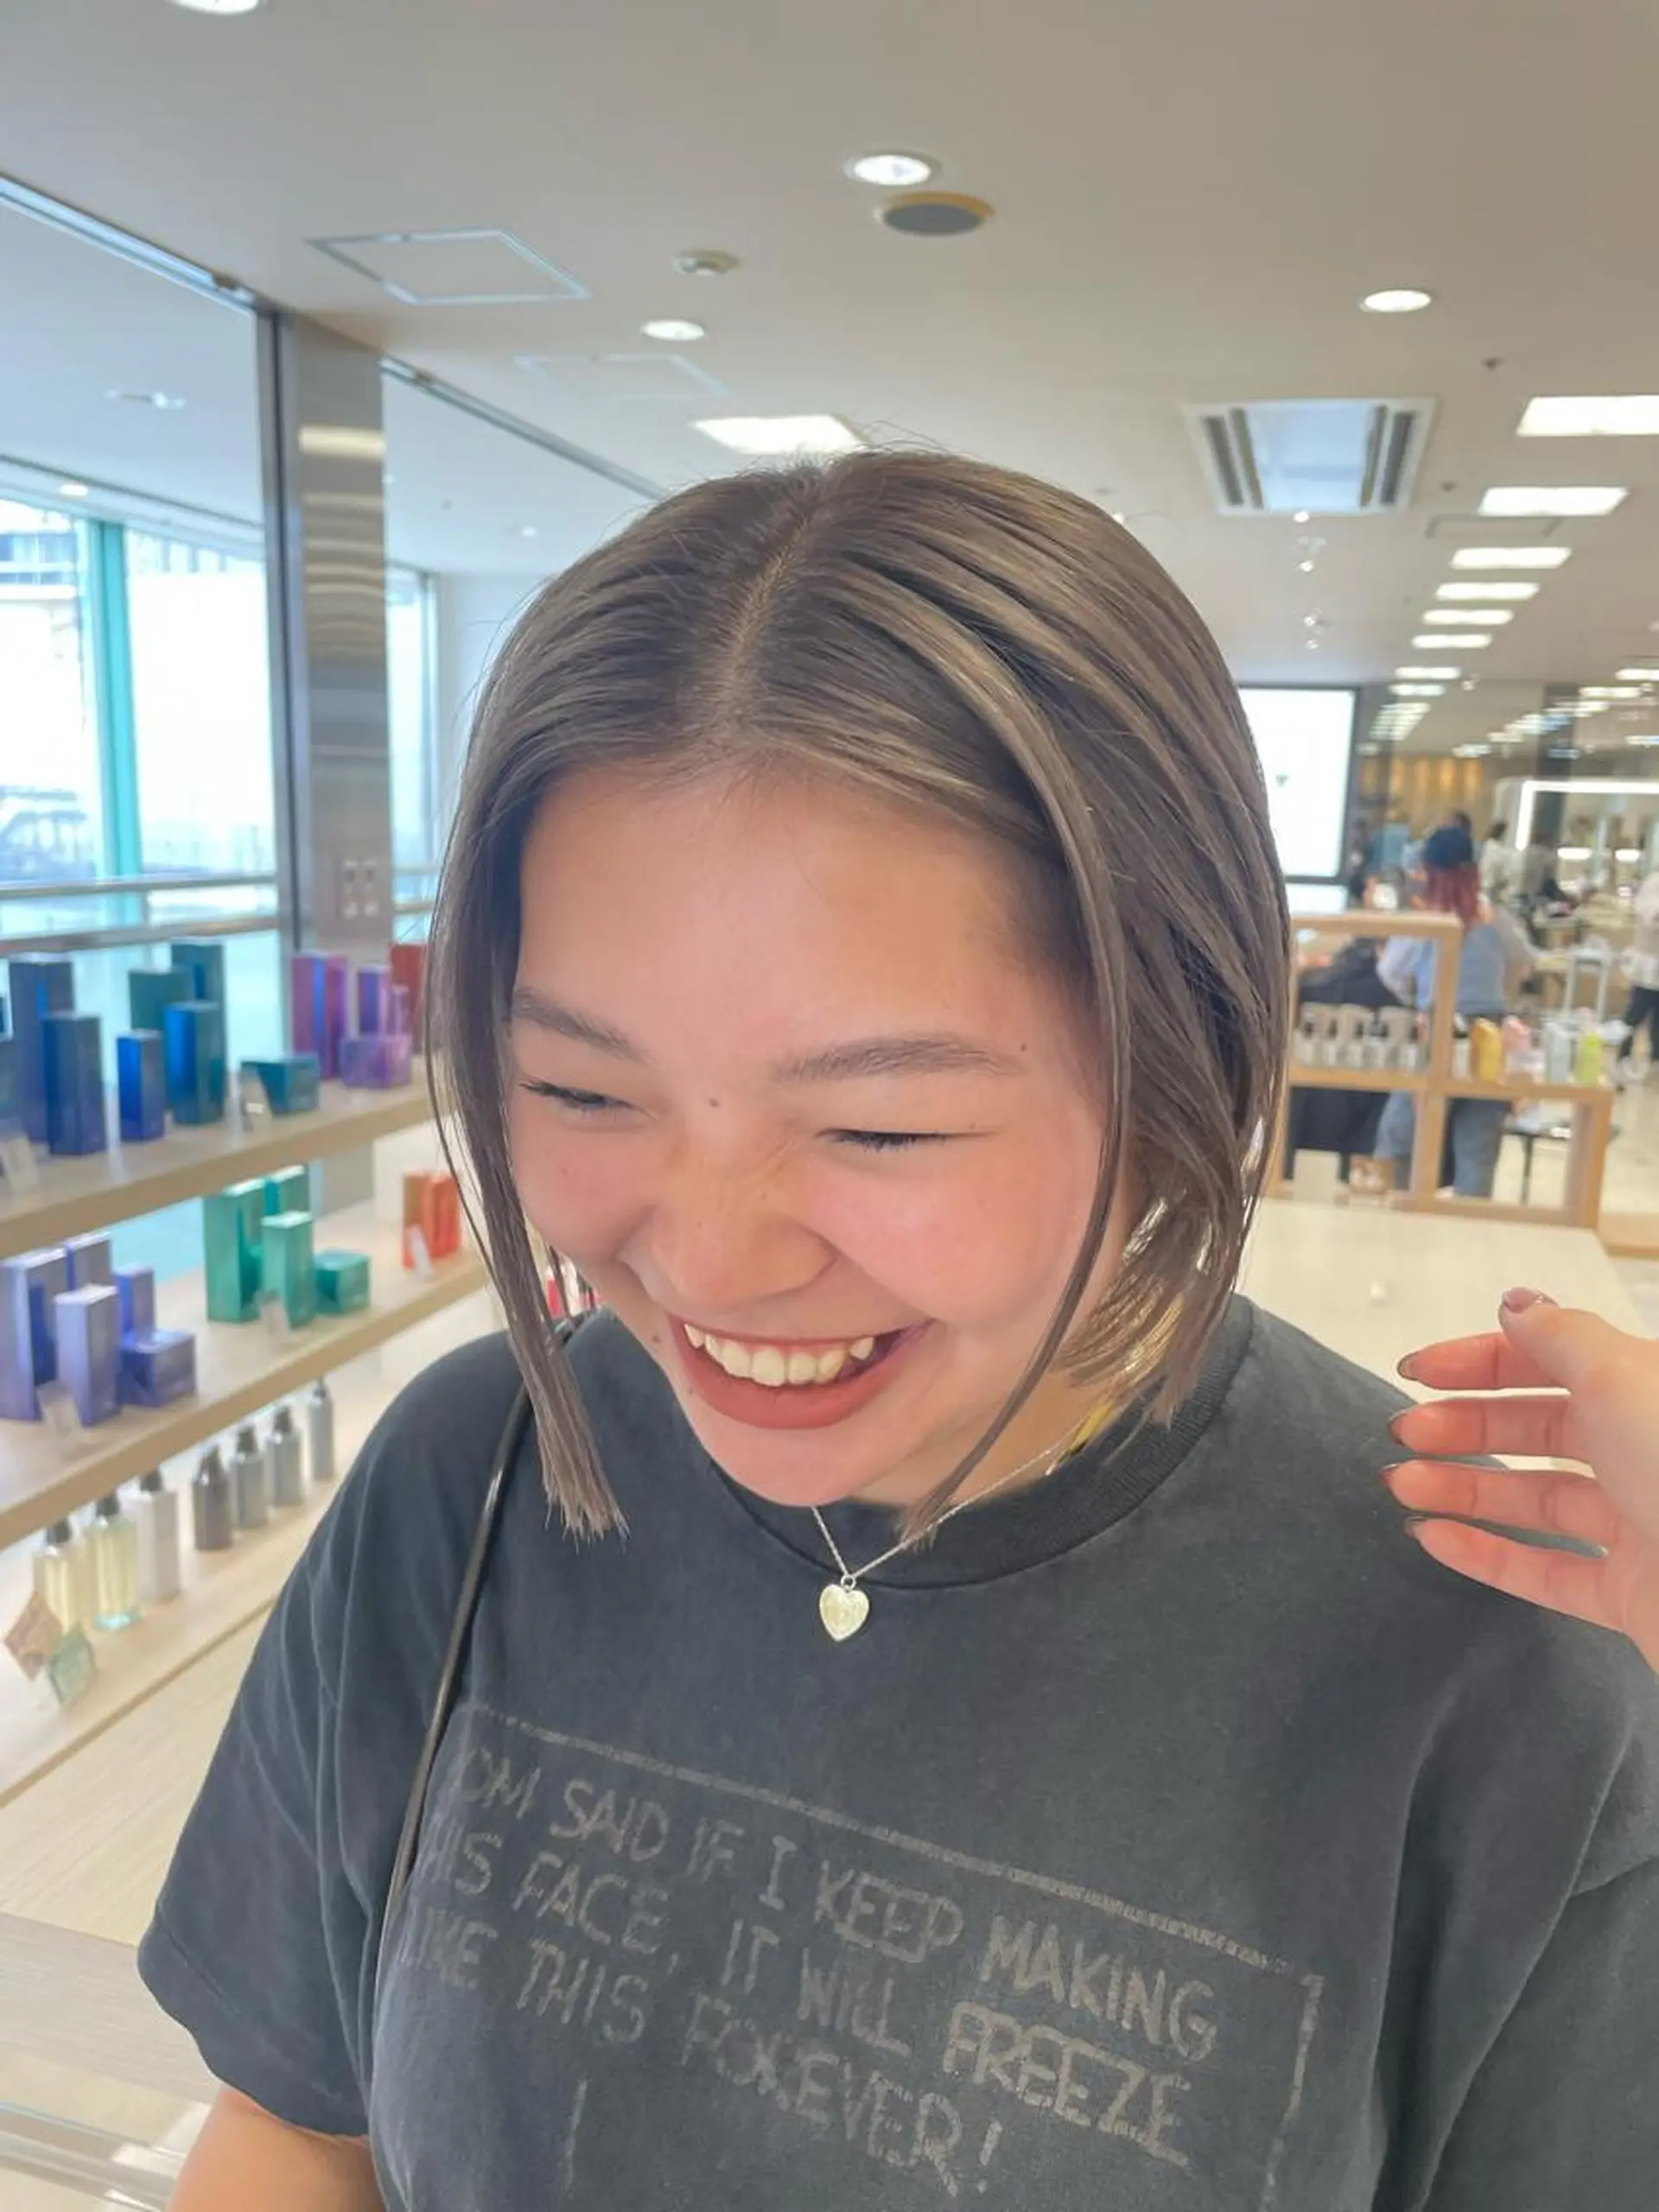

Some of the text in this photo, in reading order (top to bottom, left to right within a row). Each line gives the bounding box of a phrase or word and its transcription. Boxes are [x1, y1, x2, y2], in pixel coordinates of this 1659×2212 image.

[448, 1745, 1217, 2064] OM SAID IF I KEEP MAKING
[512, 1849, 681, 1977] FACE,
[719, 1916, 781, 1997] IT
[796, 1945, 912, 2060] WILL
[943, 2000, 1194, 2169] FREEZE
[514, 1937, 650, 2044] THIS
[678, 1992, 1004, 2199] FOREVER!
